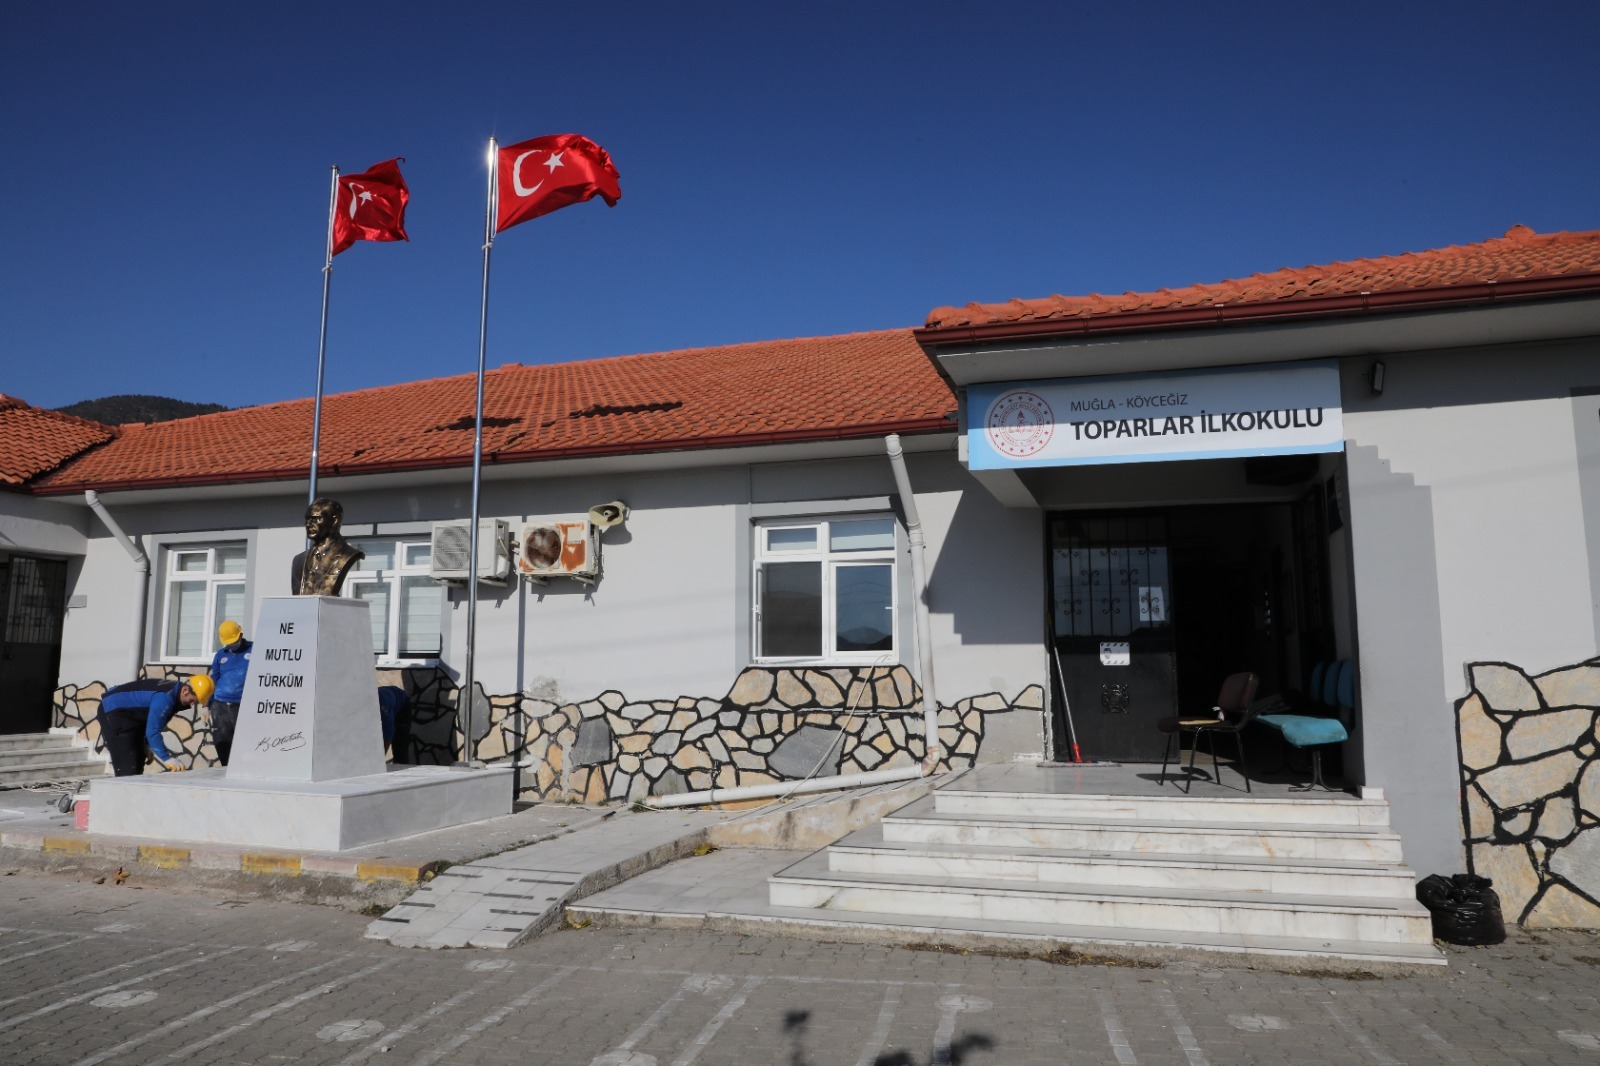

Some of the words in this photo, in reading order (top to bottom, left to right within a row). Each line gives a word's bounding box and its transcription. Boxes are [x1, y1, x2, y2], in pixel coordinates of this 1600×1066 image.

[1070, 397, 1116, 412] MUĞLA
[1126, 393, 1188, 409] KÖYCEĞİZ
[1070, 415, 1194, 440] TOPARLAR
[1200, 407, 1323, 434] İLKOKULU
[279, 622, 294, 635] NE
[265, 648, 302, 661] MUTLU
[258, 673, 303, 687] TÜRKÜM
[257, 699, 297, 714] DİYENE
